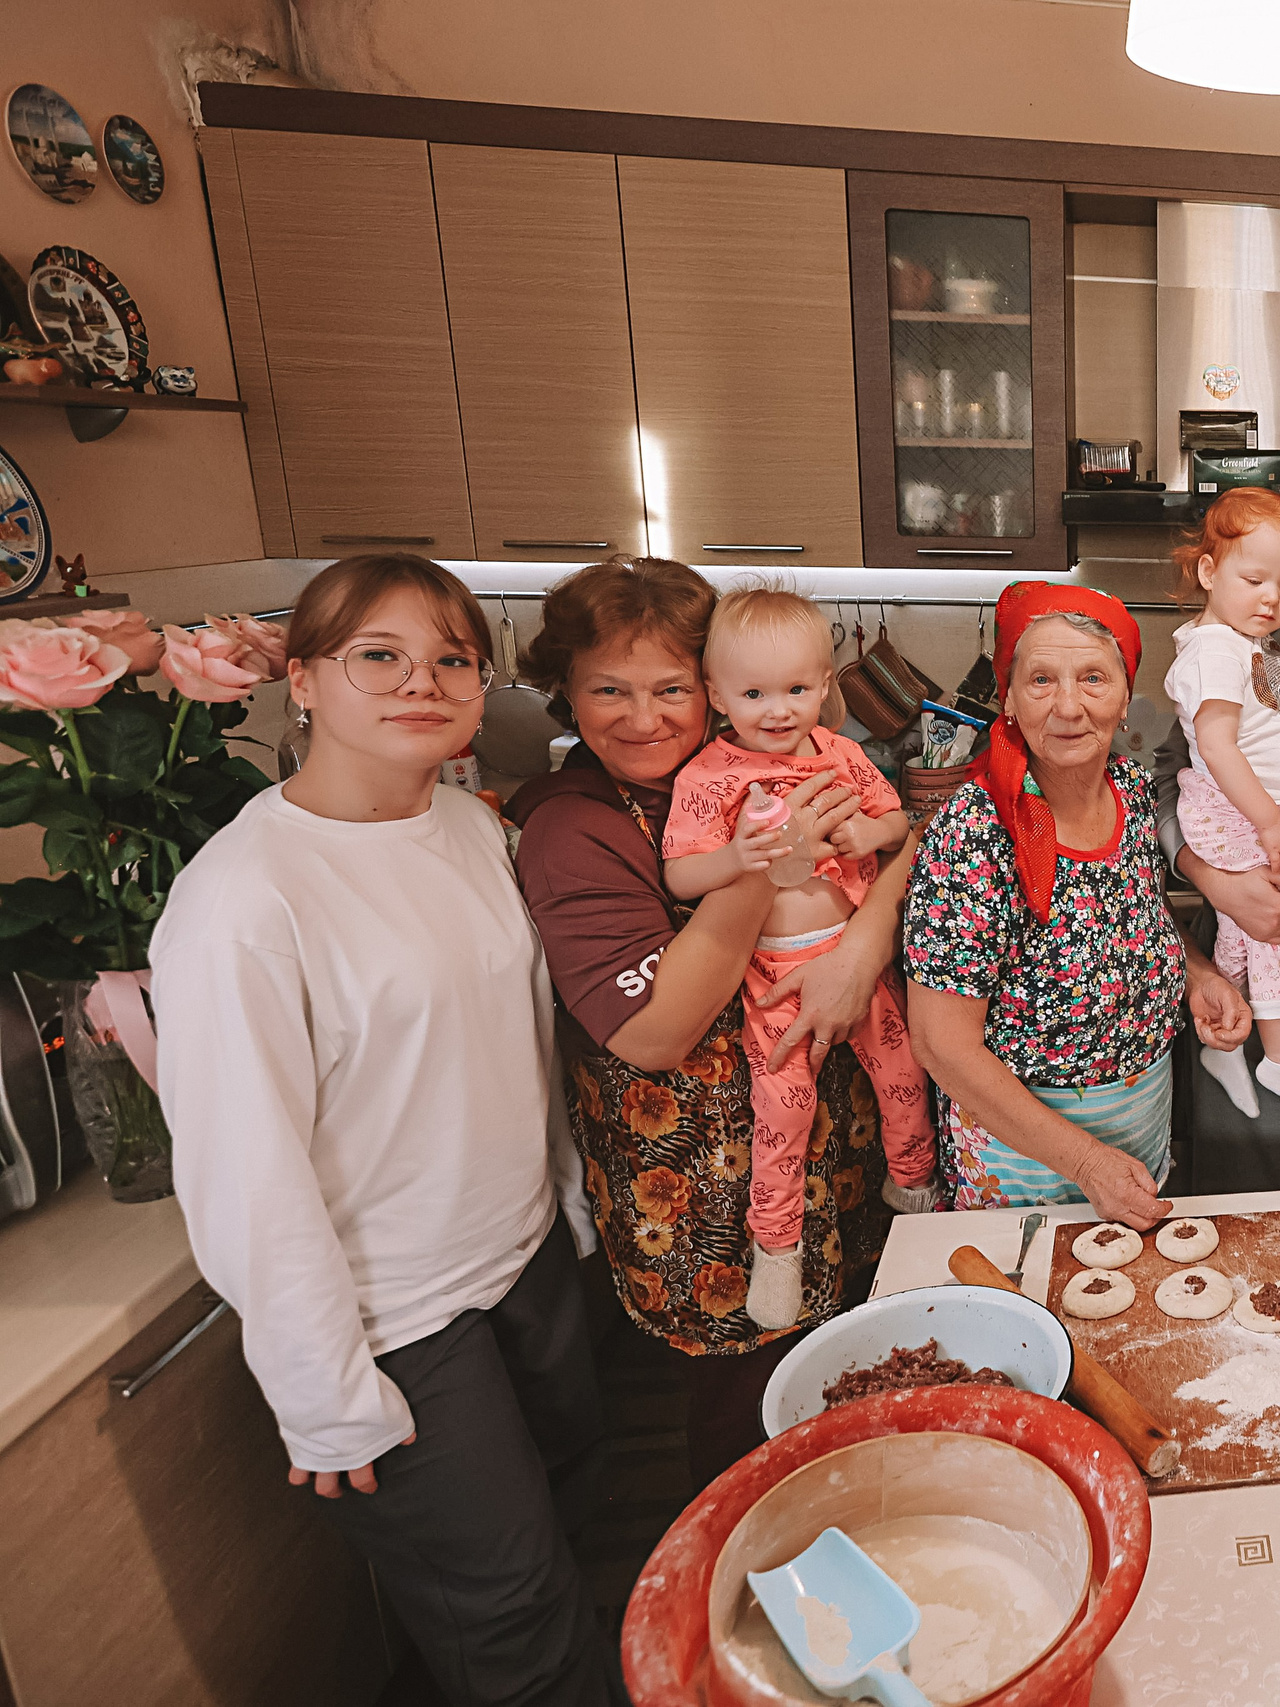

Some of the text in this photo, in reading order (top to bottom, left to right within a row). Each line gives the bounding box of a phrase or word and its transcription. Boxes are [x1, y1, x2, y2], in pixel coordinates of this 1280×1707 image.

[1221, 457, 1259, 468] Greenfield
[723, 774, 740, 797] Cute
[681, 790, 703, 813] Cute
[692, 798, 720, 822] Kitty
[615, 946, 665, 998] SO
[780, 1085, 802, 1109] Cute
[882, 1083, 902, 1100] Cute
[895, 1083, 922, 1105] Kitty
[778, 1154, 800, 1176] Cute
